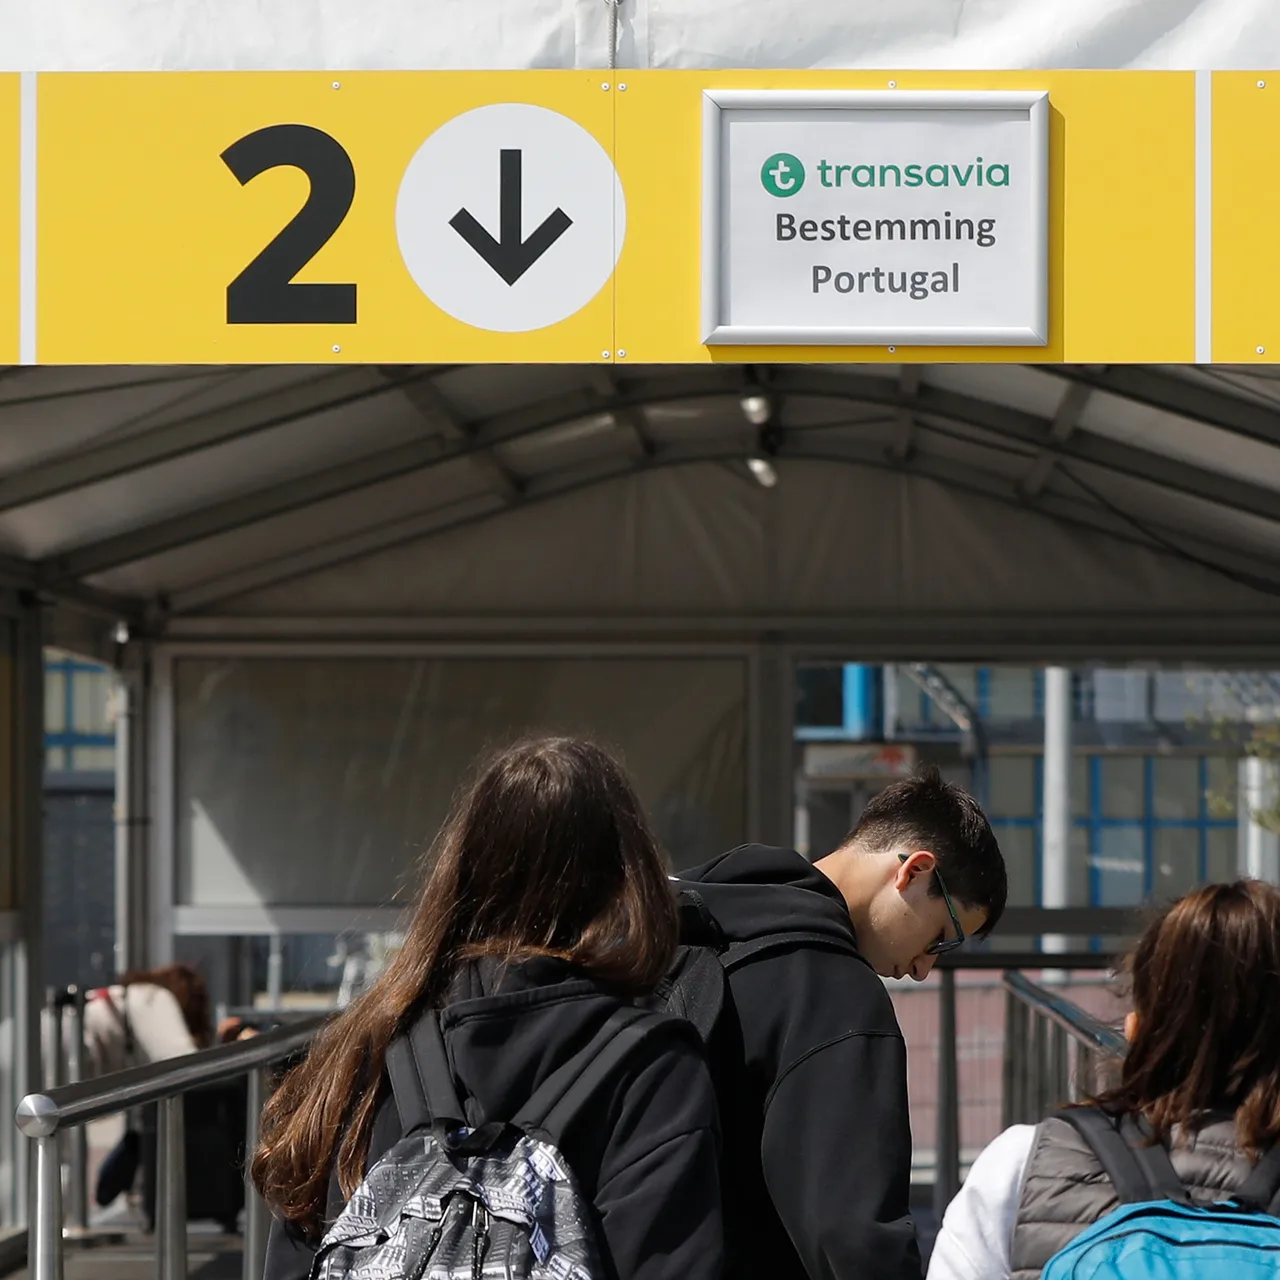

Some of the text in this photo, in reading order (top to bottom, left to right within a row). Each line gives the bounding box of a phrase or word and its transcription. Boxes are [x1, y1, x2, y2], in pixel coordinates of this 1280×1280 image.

[816, 156, 1010, 188] transavia
[219, 123, 358, 325] 2
[775, 211, 997, 248] Bestemming
[811, 262, 960, 300] Portugal
